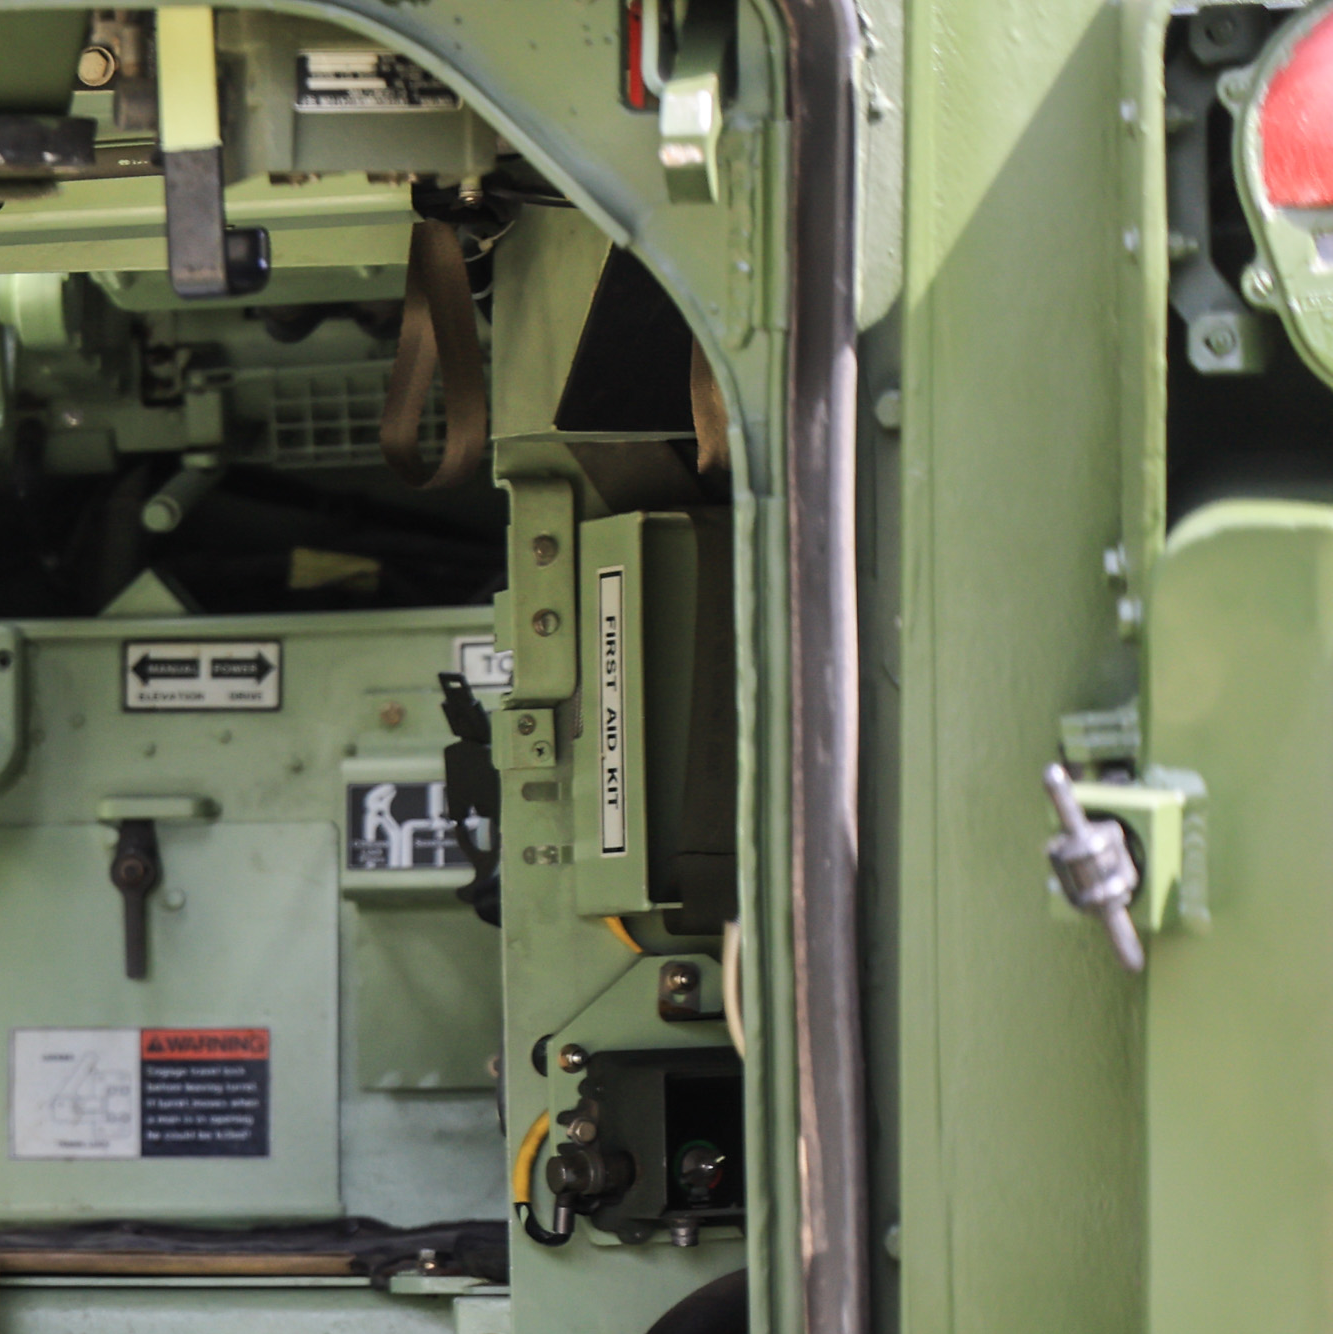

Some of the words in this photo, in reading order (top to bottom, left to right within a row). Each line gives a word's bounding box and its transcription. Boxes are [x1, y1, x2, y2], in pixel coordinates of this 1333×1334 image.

[147, 663, 199, 673] MANUAL
[213, 663, 259, 673] POWER
[605, 615, 618, 692] FIRST
[138, 692, 206, 701] ELEVATION
[606, 707, 618, 752] AID
[606, 767, 619, 810] KIT
[166, 1036, 266, 1053] WARNING
